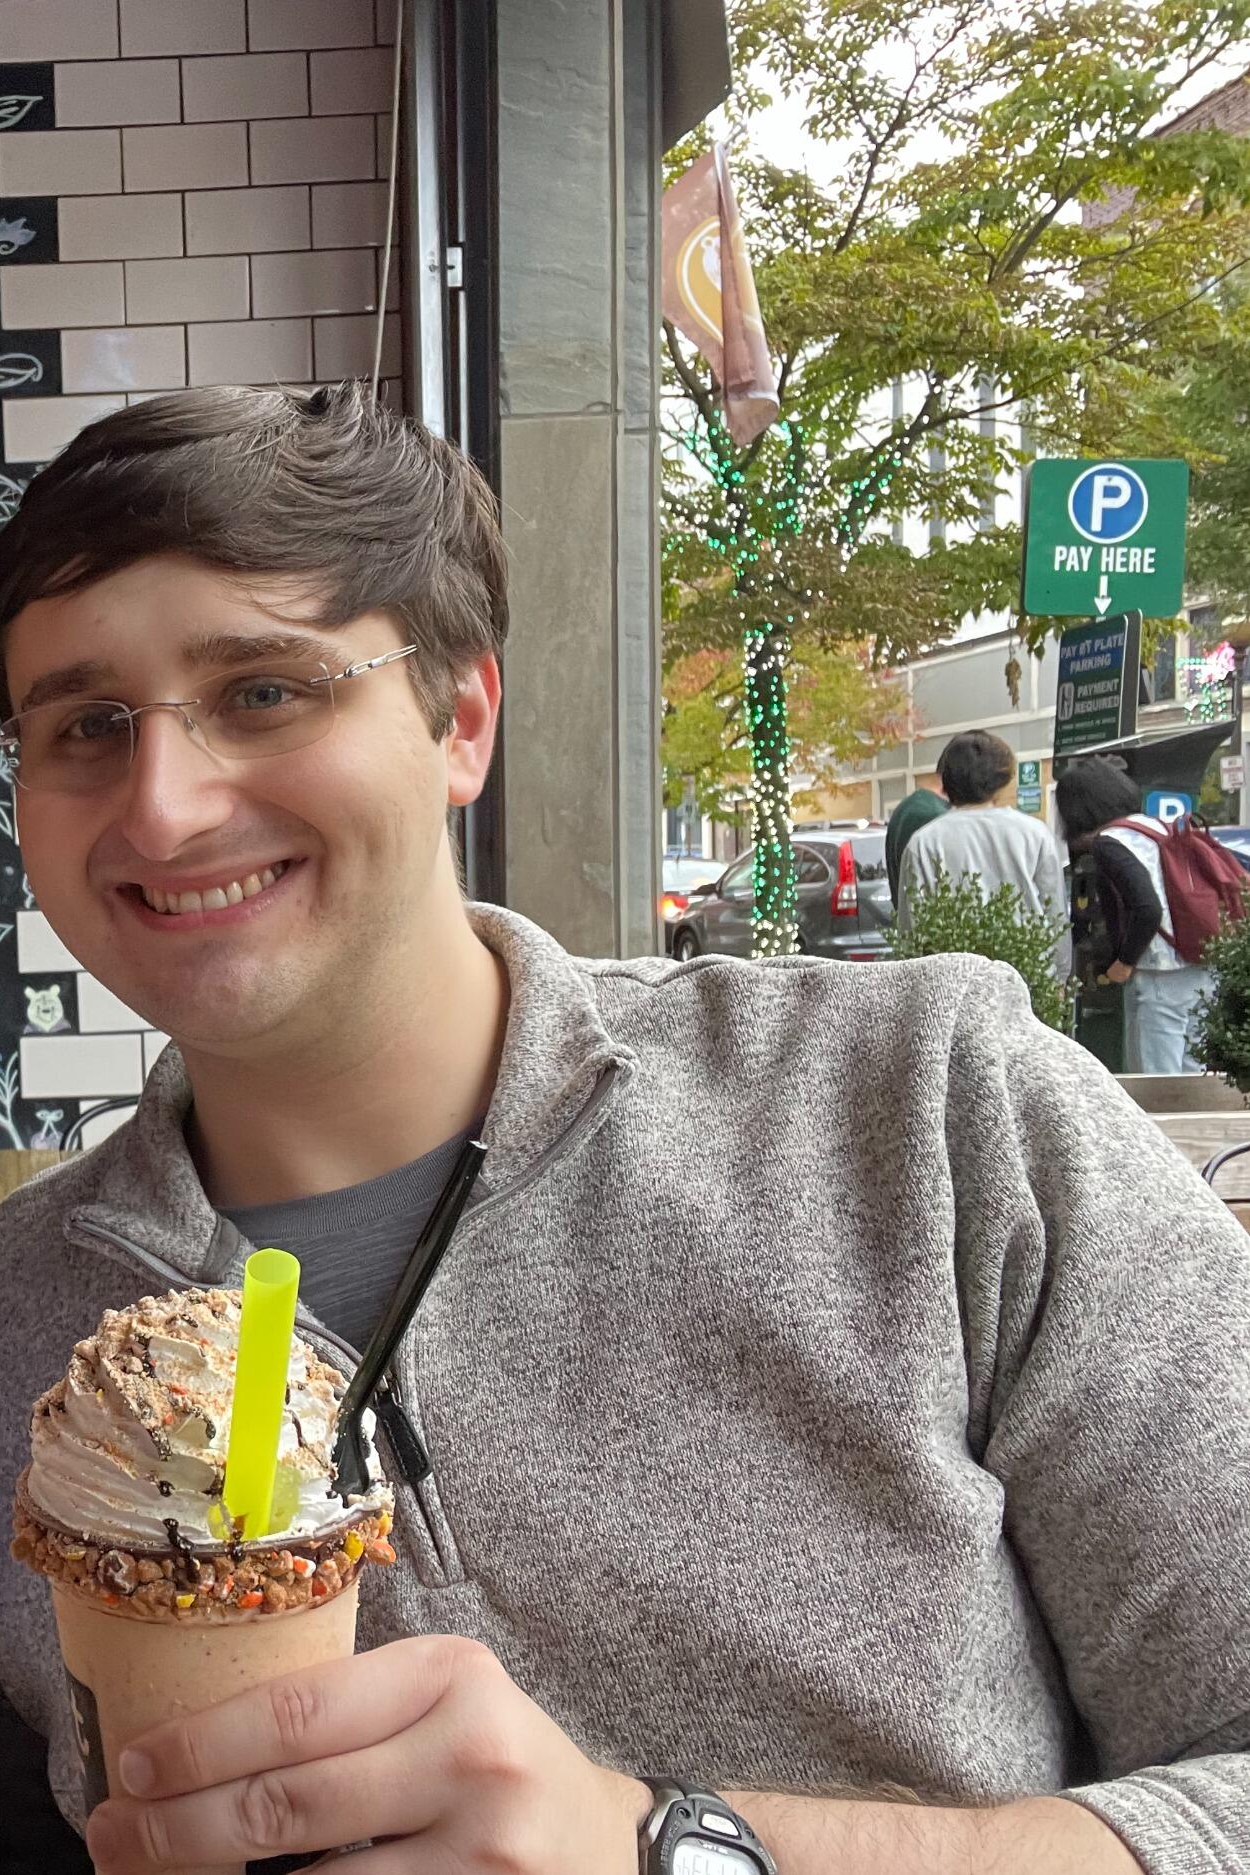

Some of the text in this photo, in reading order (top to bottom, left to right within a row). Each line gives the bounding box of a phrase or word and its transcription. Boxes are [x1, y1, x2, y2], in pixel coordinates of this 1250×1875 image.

[1053, 545, 1156, 573] PAY HERE
[1060, 645, 1078, 659] PAY
[1094, 633, 1125, 653] PLATE
[1069, 654, 1112, 674] PARKING
[1077, 679, 1120, 698] PAYMENT
[1075, 695, 1121, 714] REQUIRED
